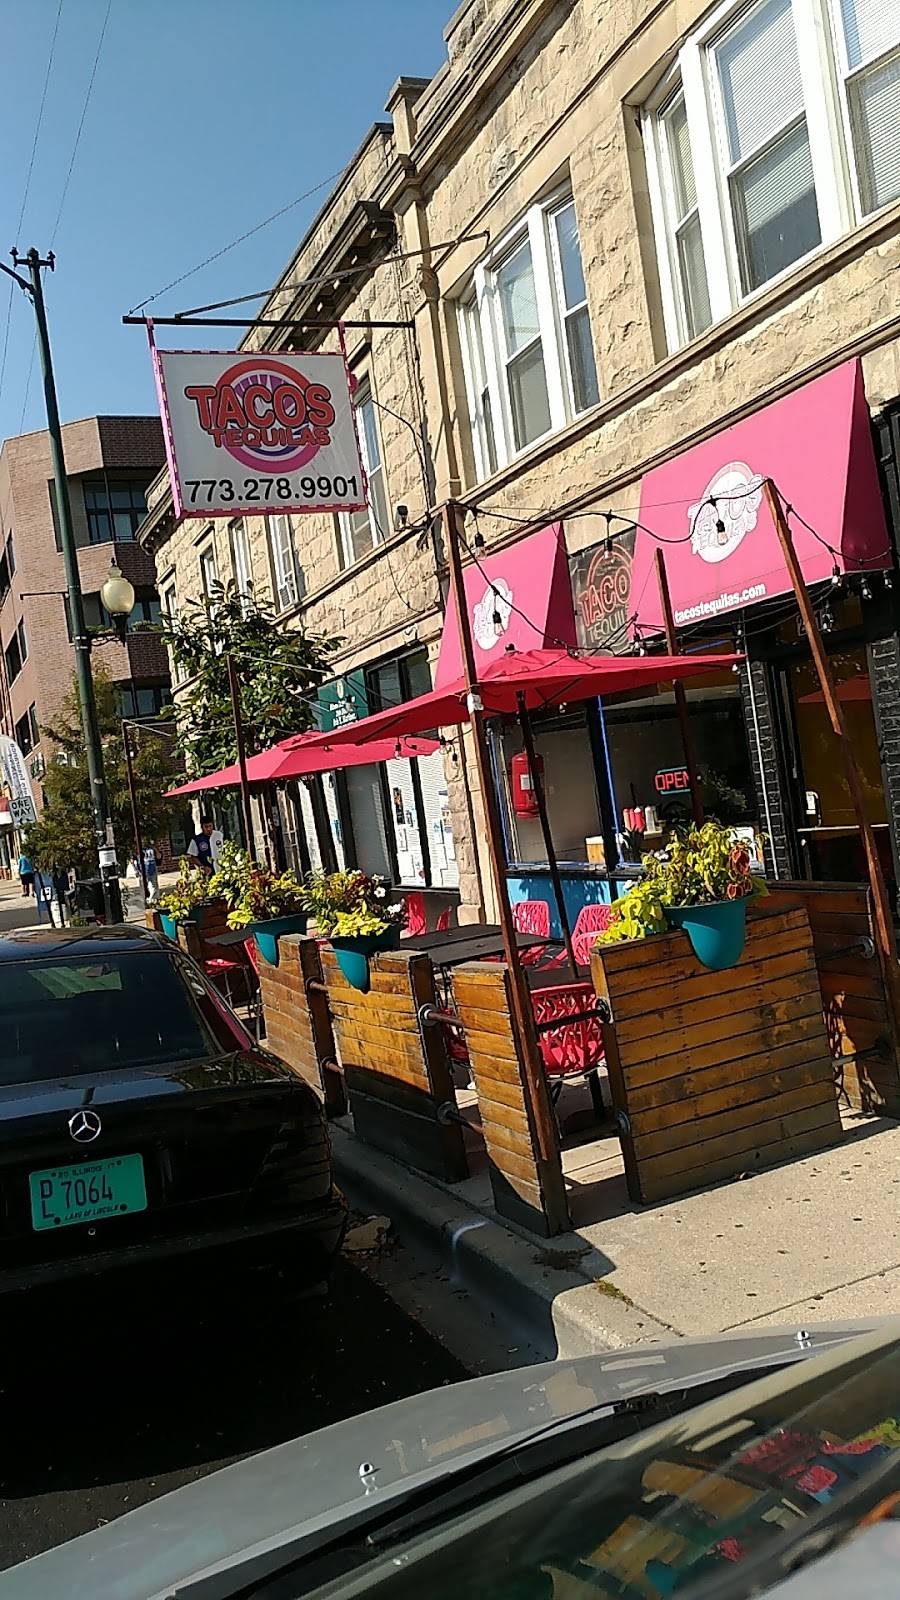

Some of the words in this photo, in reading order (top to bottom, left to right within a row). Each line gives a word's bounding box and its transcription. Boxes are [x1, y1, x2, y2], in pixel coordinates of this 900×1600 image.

[184, 384, 336, 429] TACOS
[208, 426, 331, 448] TEQUILAS
[184, 475, 358, 503] 773.278.9901
[578, 566, 631, 627] TACO
[674, 583, 766, 623] tacostequilas.com
[655, 770, 690, 791] OPEN
[11, 799, 30, 810] ONE
[13, 806, 31, 818] WAY
[61, 1174, 113, 1209] 7064
